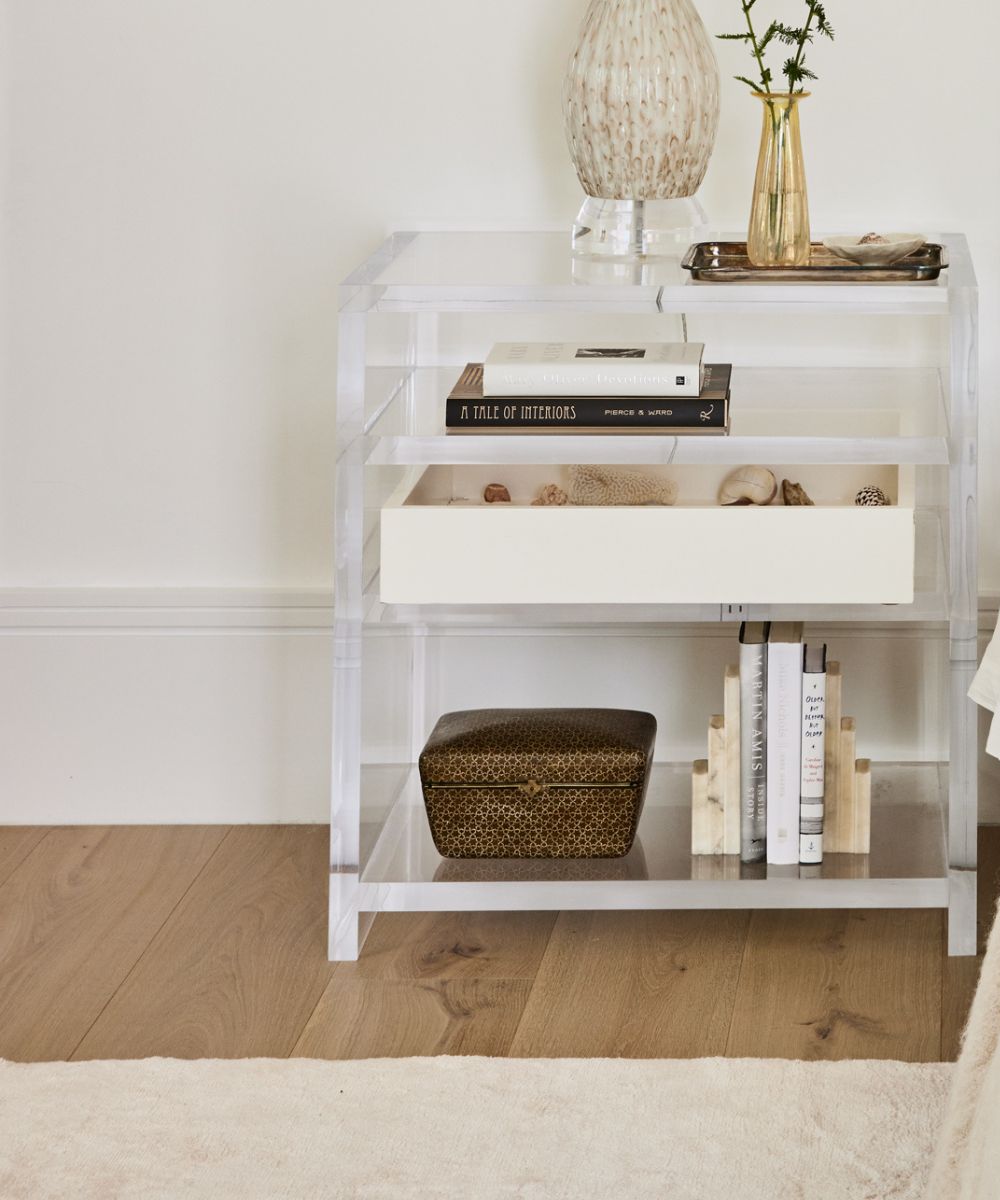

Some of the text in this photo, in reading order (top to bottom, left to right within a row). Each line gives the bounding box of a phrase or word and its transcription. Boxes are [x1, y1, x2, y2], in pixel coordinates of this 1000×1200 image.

[596, 373, 669, 385] Devotions
[461, 406, 577, 420] A TALE OF INTERIORS
[751, 655, 763, 771] MARTIN AMIS
[746, 787, 755, 819] STORY
[757, 784, 765, 822] INSIDE
